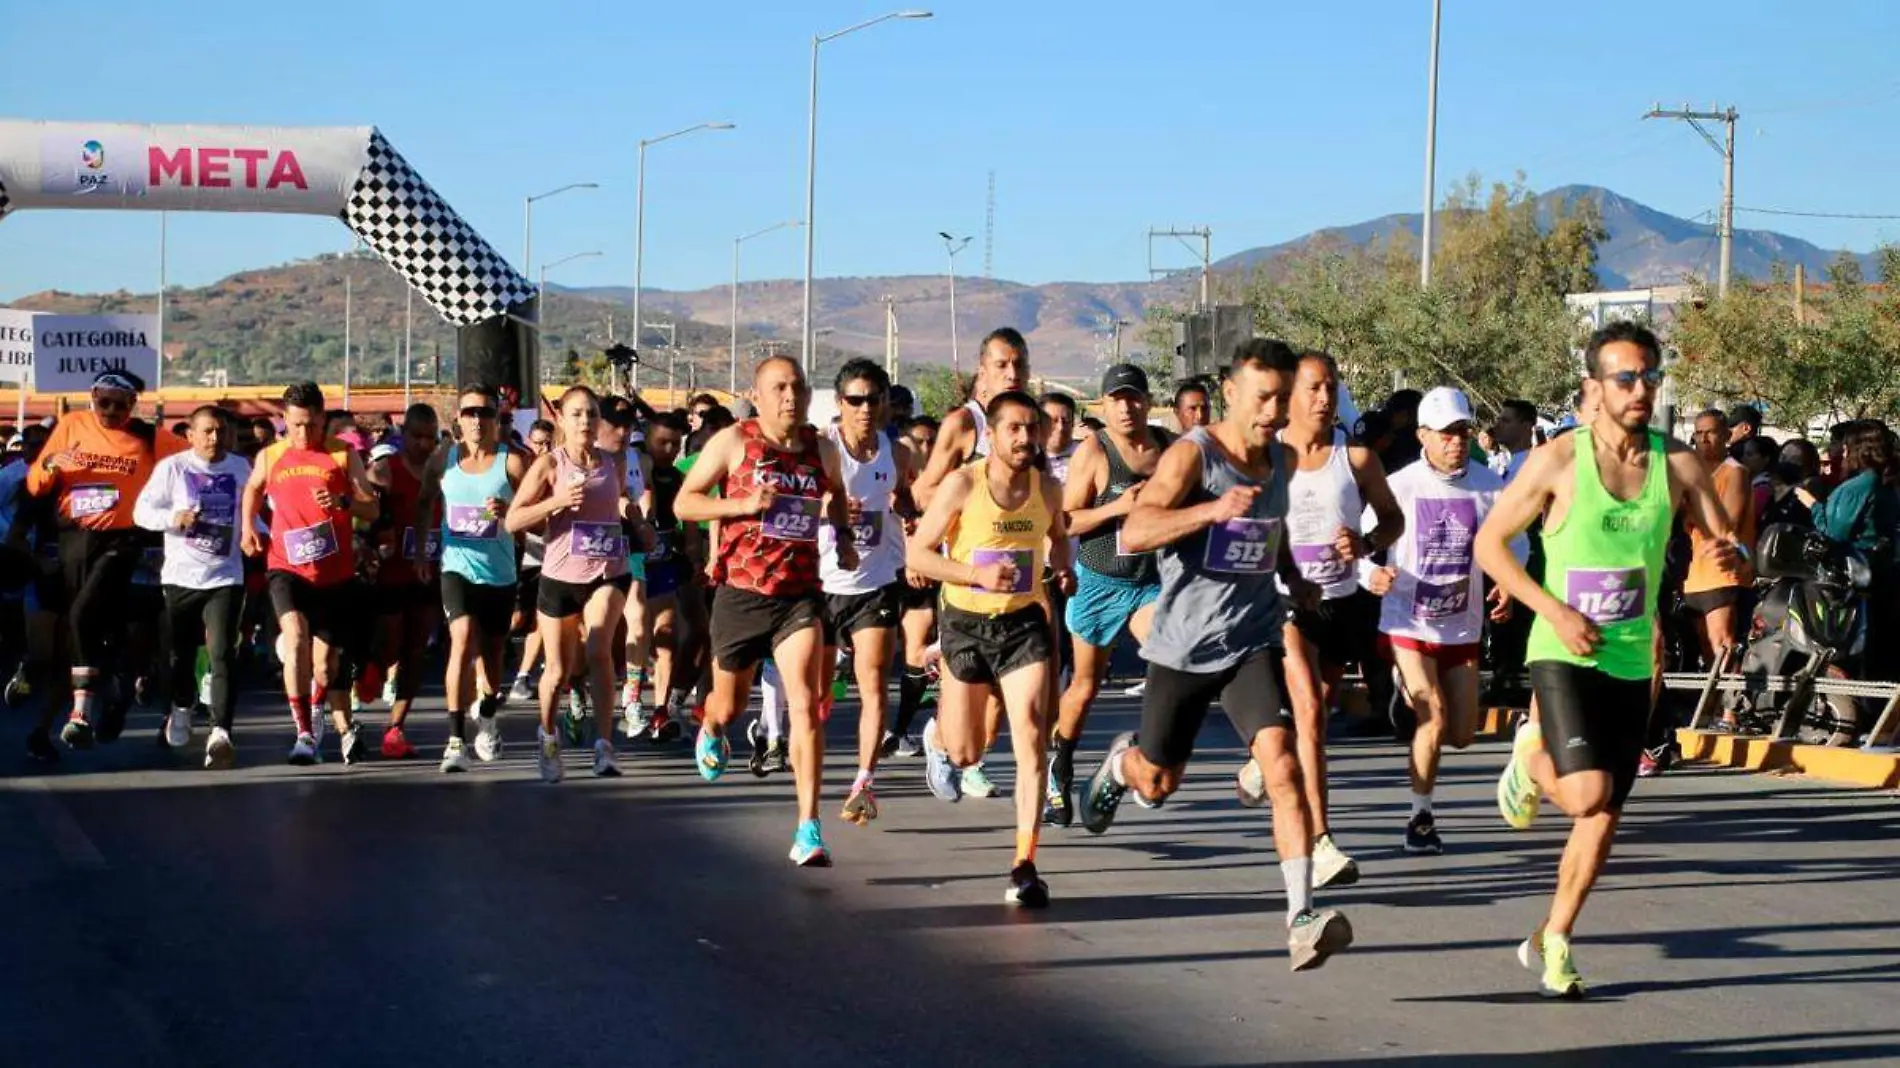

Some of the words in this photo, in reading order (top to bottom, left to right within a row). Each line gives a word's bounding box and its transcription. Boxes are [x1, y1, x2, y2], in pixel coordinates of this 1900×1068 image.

[149, 147, 308, 190] META
[80, 174, 109, 186] PAZ
[41, 327, 148, 349] CATEGORÍA
[774, 512, 811, 532] 025
[1223, 540, 1267, 563] 513
